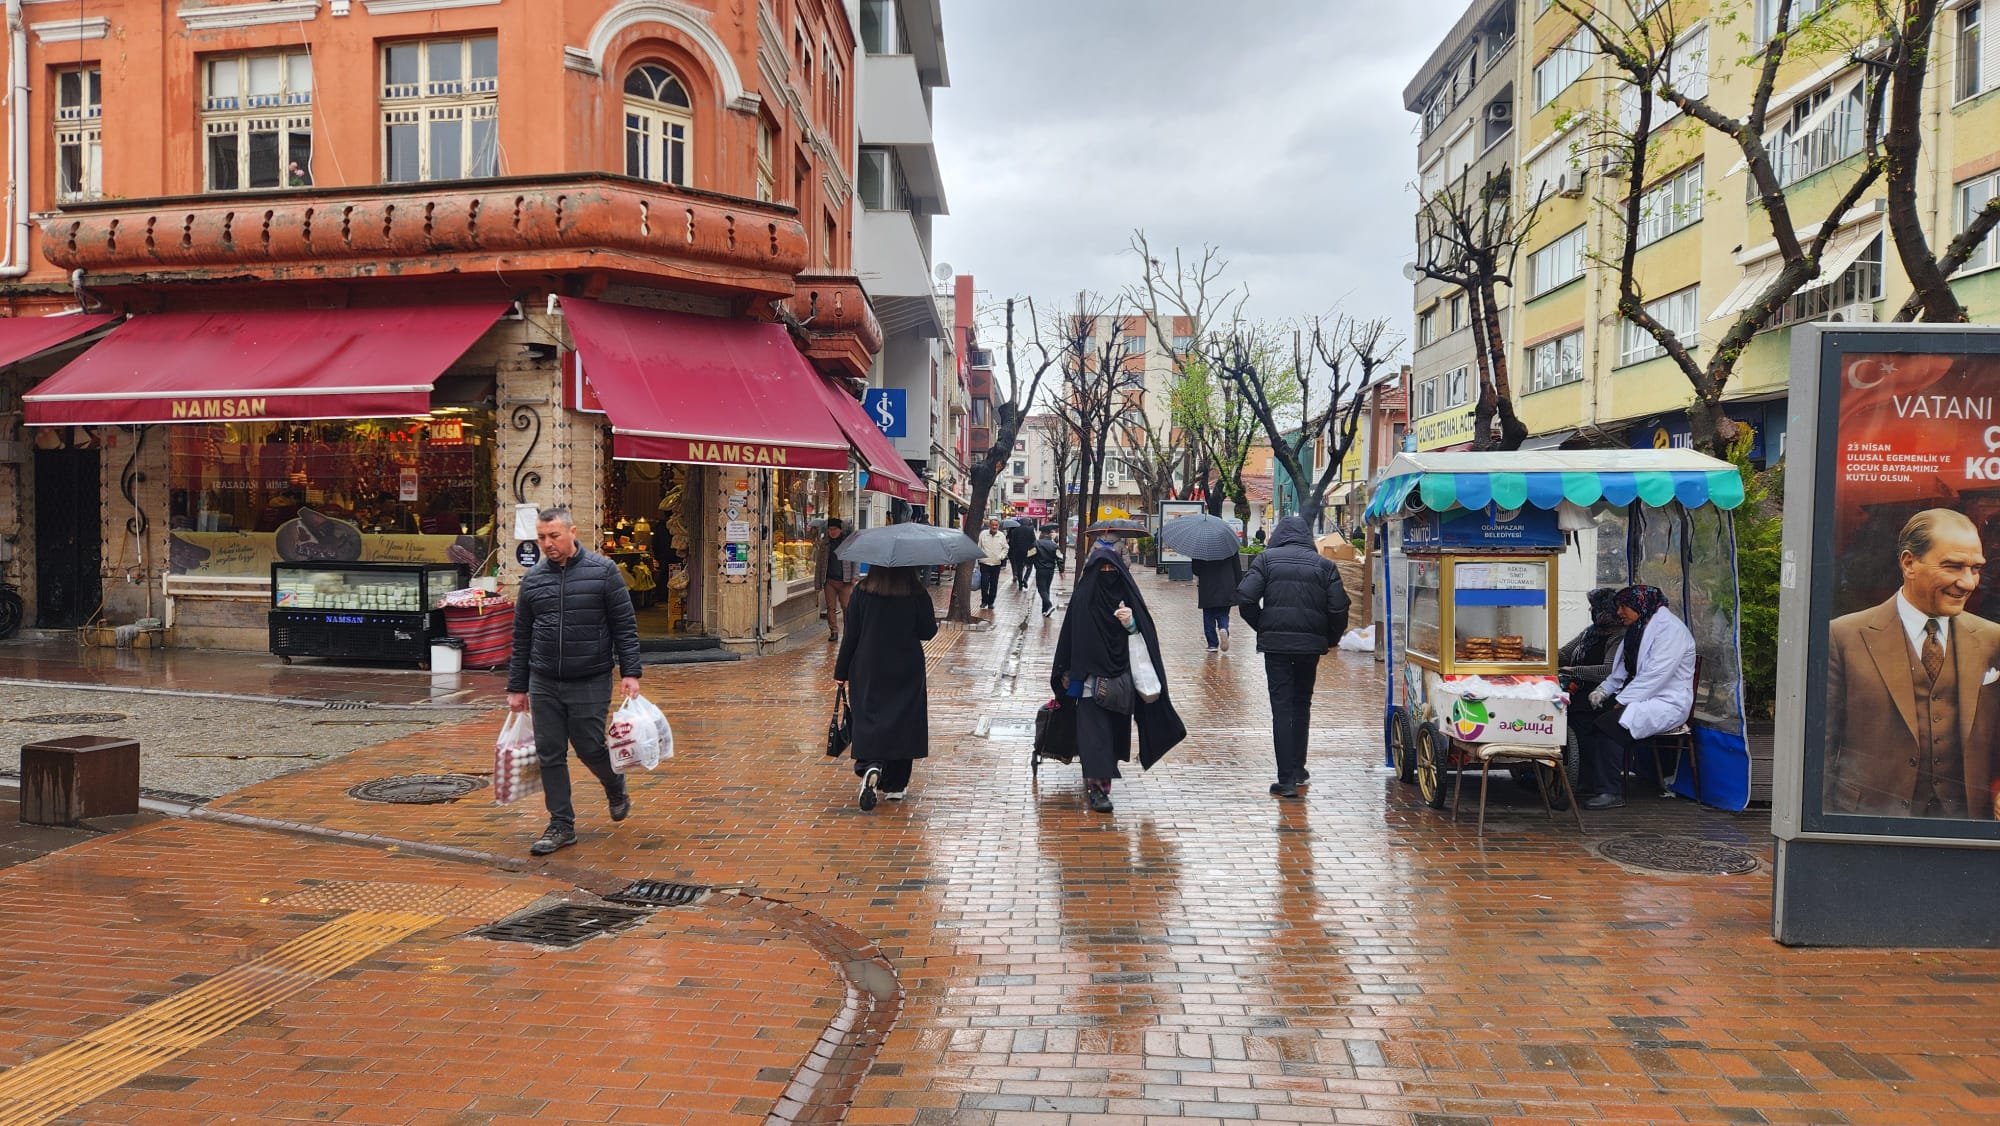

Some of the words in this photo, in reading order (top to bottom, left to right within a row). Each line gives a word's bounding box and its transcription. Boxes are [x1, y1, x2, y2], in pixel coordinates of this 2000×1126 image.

[172, 398, 267, 418] NAMSAN
[1893, 395, 1993, 420] VATANI
[432, 424, 461, 439] KASA
[1437, 416, 1459, 440] TERMAL
[1847, 443, 1859, 451] 23
[1862, 443, 1891, 451] NİSAN
[1984, 425, 2000, 453] Ç
[688, 442, 787, 465] NAMSAN
[1847, 453, 1883, 461] ULUSAL
[1886, 453, 1938, 463] EGEMENLİK
[1846, 464, 1880, 473] ÇOCUK
[1882, 464, 1939, 473] BAYRAMIMIZ
[1965, 456, 2000, 481] KO
[1846, 474, 1877, 482] KUTLU
[1880, 474, 1913, 482] OLSUN.
[325, 615, 364, 624] NAMSAN
